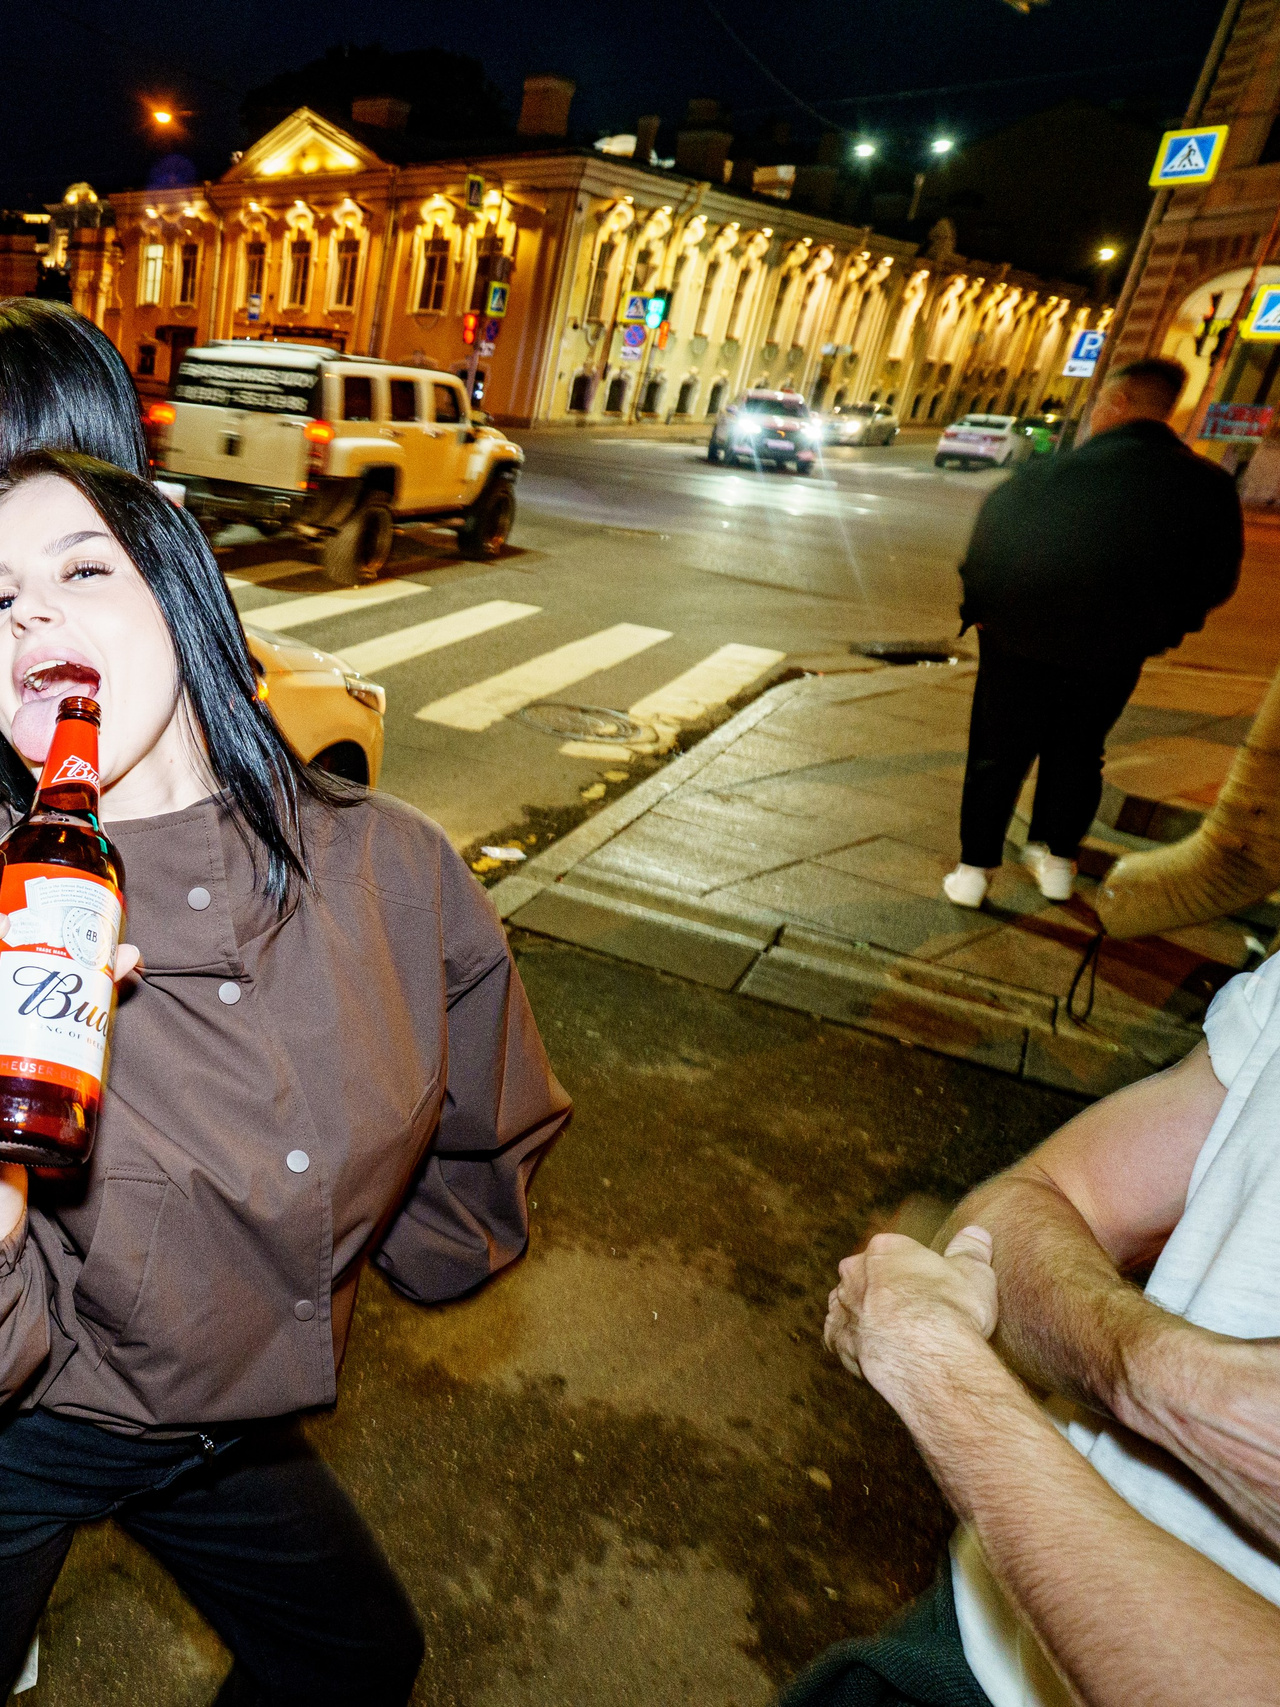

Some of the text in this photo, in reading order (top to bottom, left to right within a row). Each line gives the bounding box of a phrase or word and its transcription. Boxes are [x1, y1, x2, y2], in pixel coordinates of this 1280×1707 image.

[36, 946, 67, 956] TRADE MARK
[68, 1030, 82, 1040] OF
